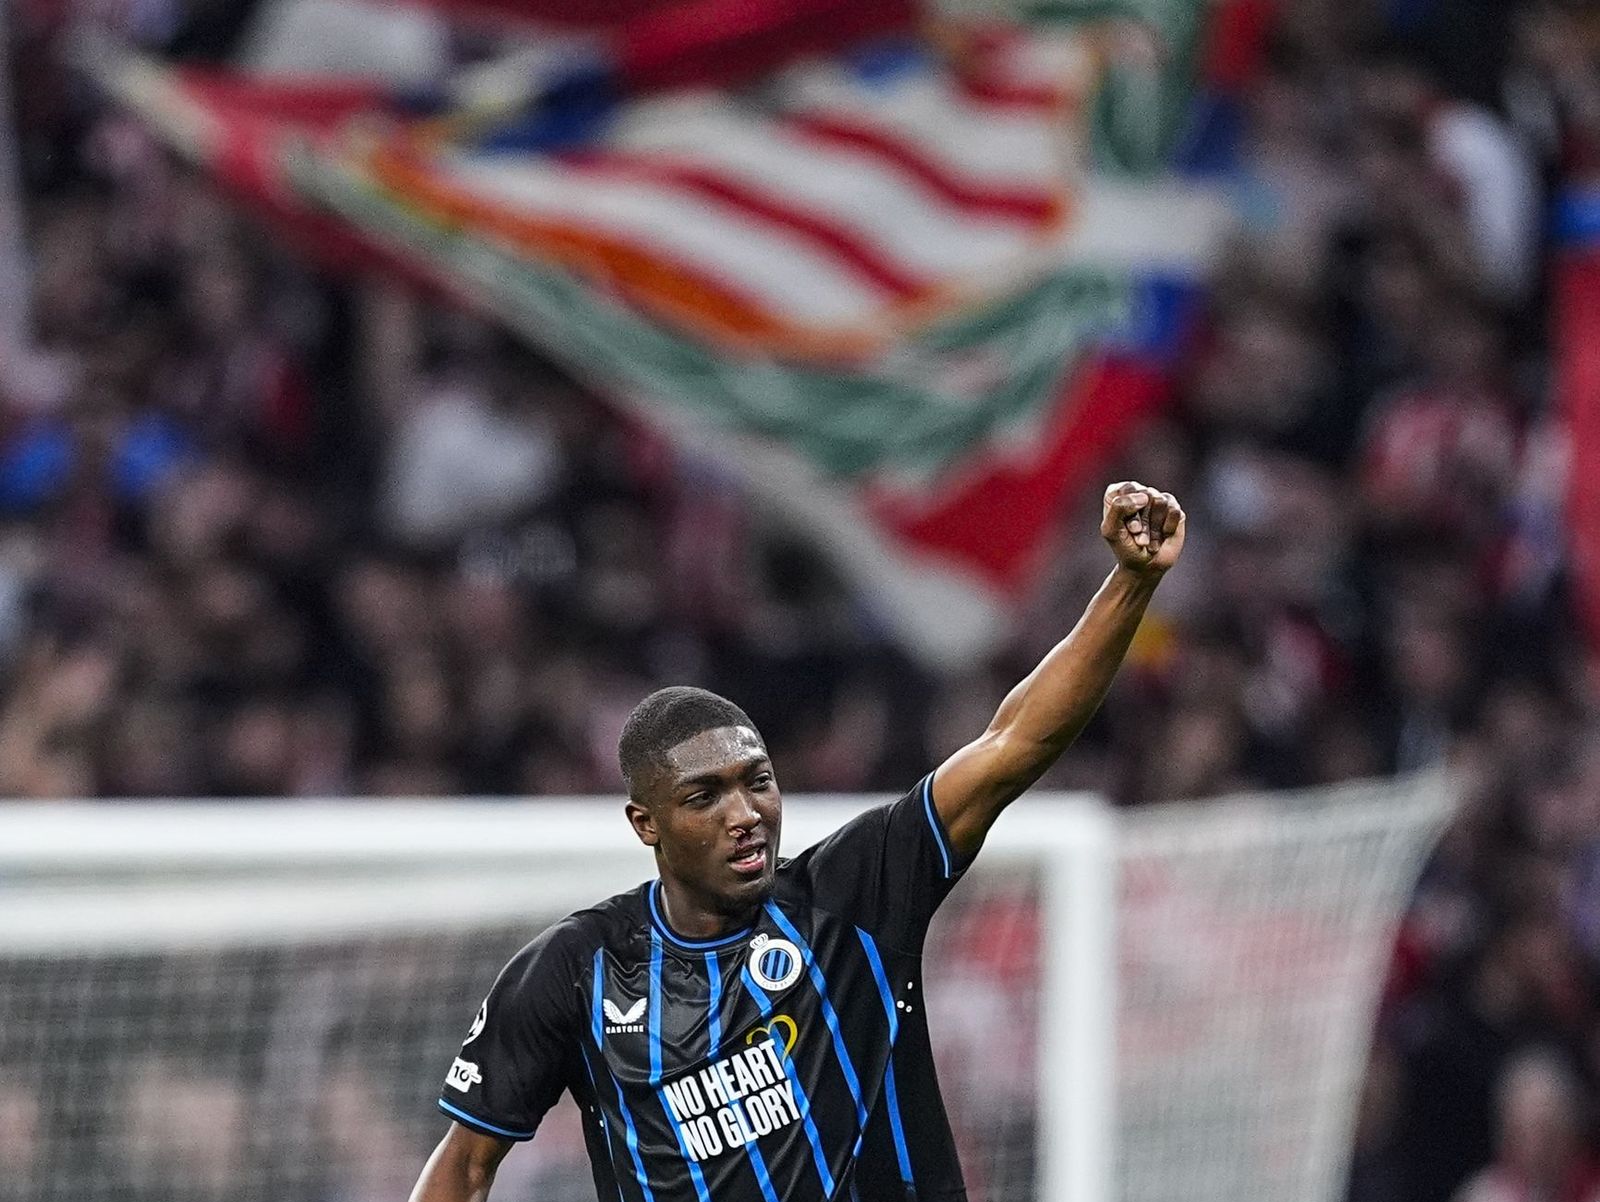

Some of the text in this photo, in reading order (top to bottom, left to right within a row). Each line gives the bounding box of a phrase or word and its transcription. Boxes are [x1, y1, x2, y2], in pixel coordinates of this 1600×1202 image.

[605, 1024, 644, 1034] CASTORE
[663, 1038, 786, 1122] NO HEART
[679, 1079, 801, 1162] NO GLORY
